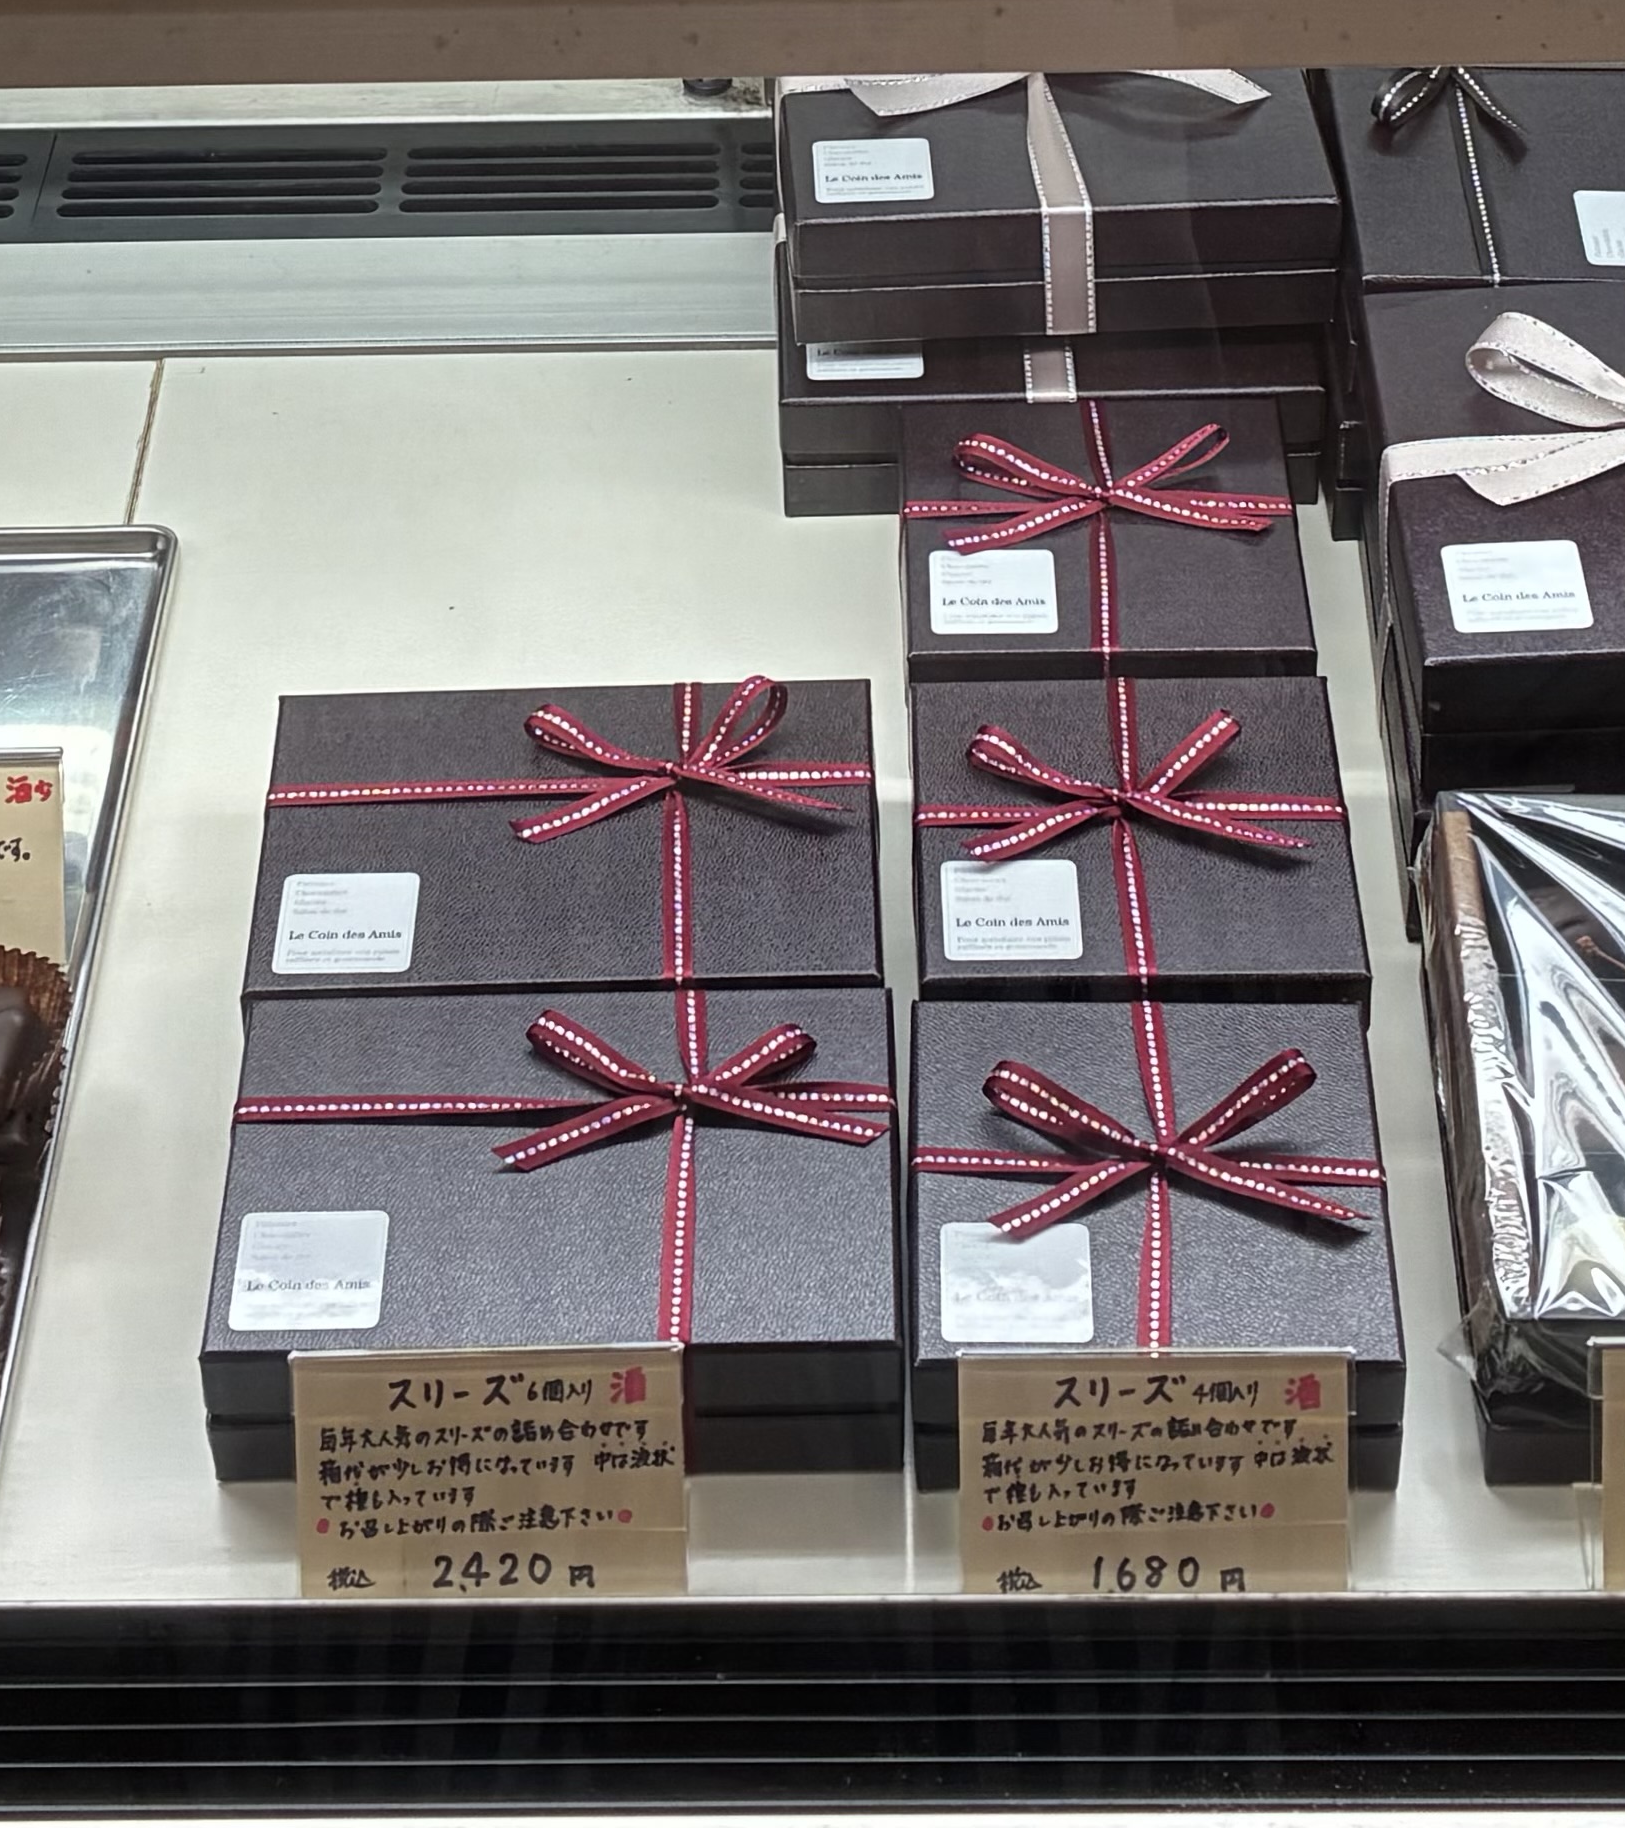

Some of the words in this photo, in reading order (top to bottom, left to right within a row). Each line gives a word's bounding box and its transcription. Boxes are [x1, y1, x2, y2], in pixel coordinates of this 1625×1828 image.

[974, 918, 1006, 927] Coin
[1010, 917, 1032, 927] des
[1036, 918, 1069, 927] Amis
[289, 930, 304, 940] Le
[308, 930, 339, 940] Coin
[342, 930, 365, 939] des
[327, 1566, 376, 1591] 税込
